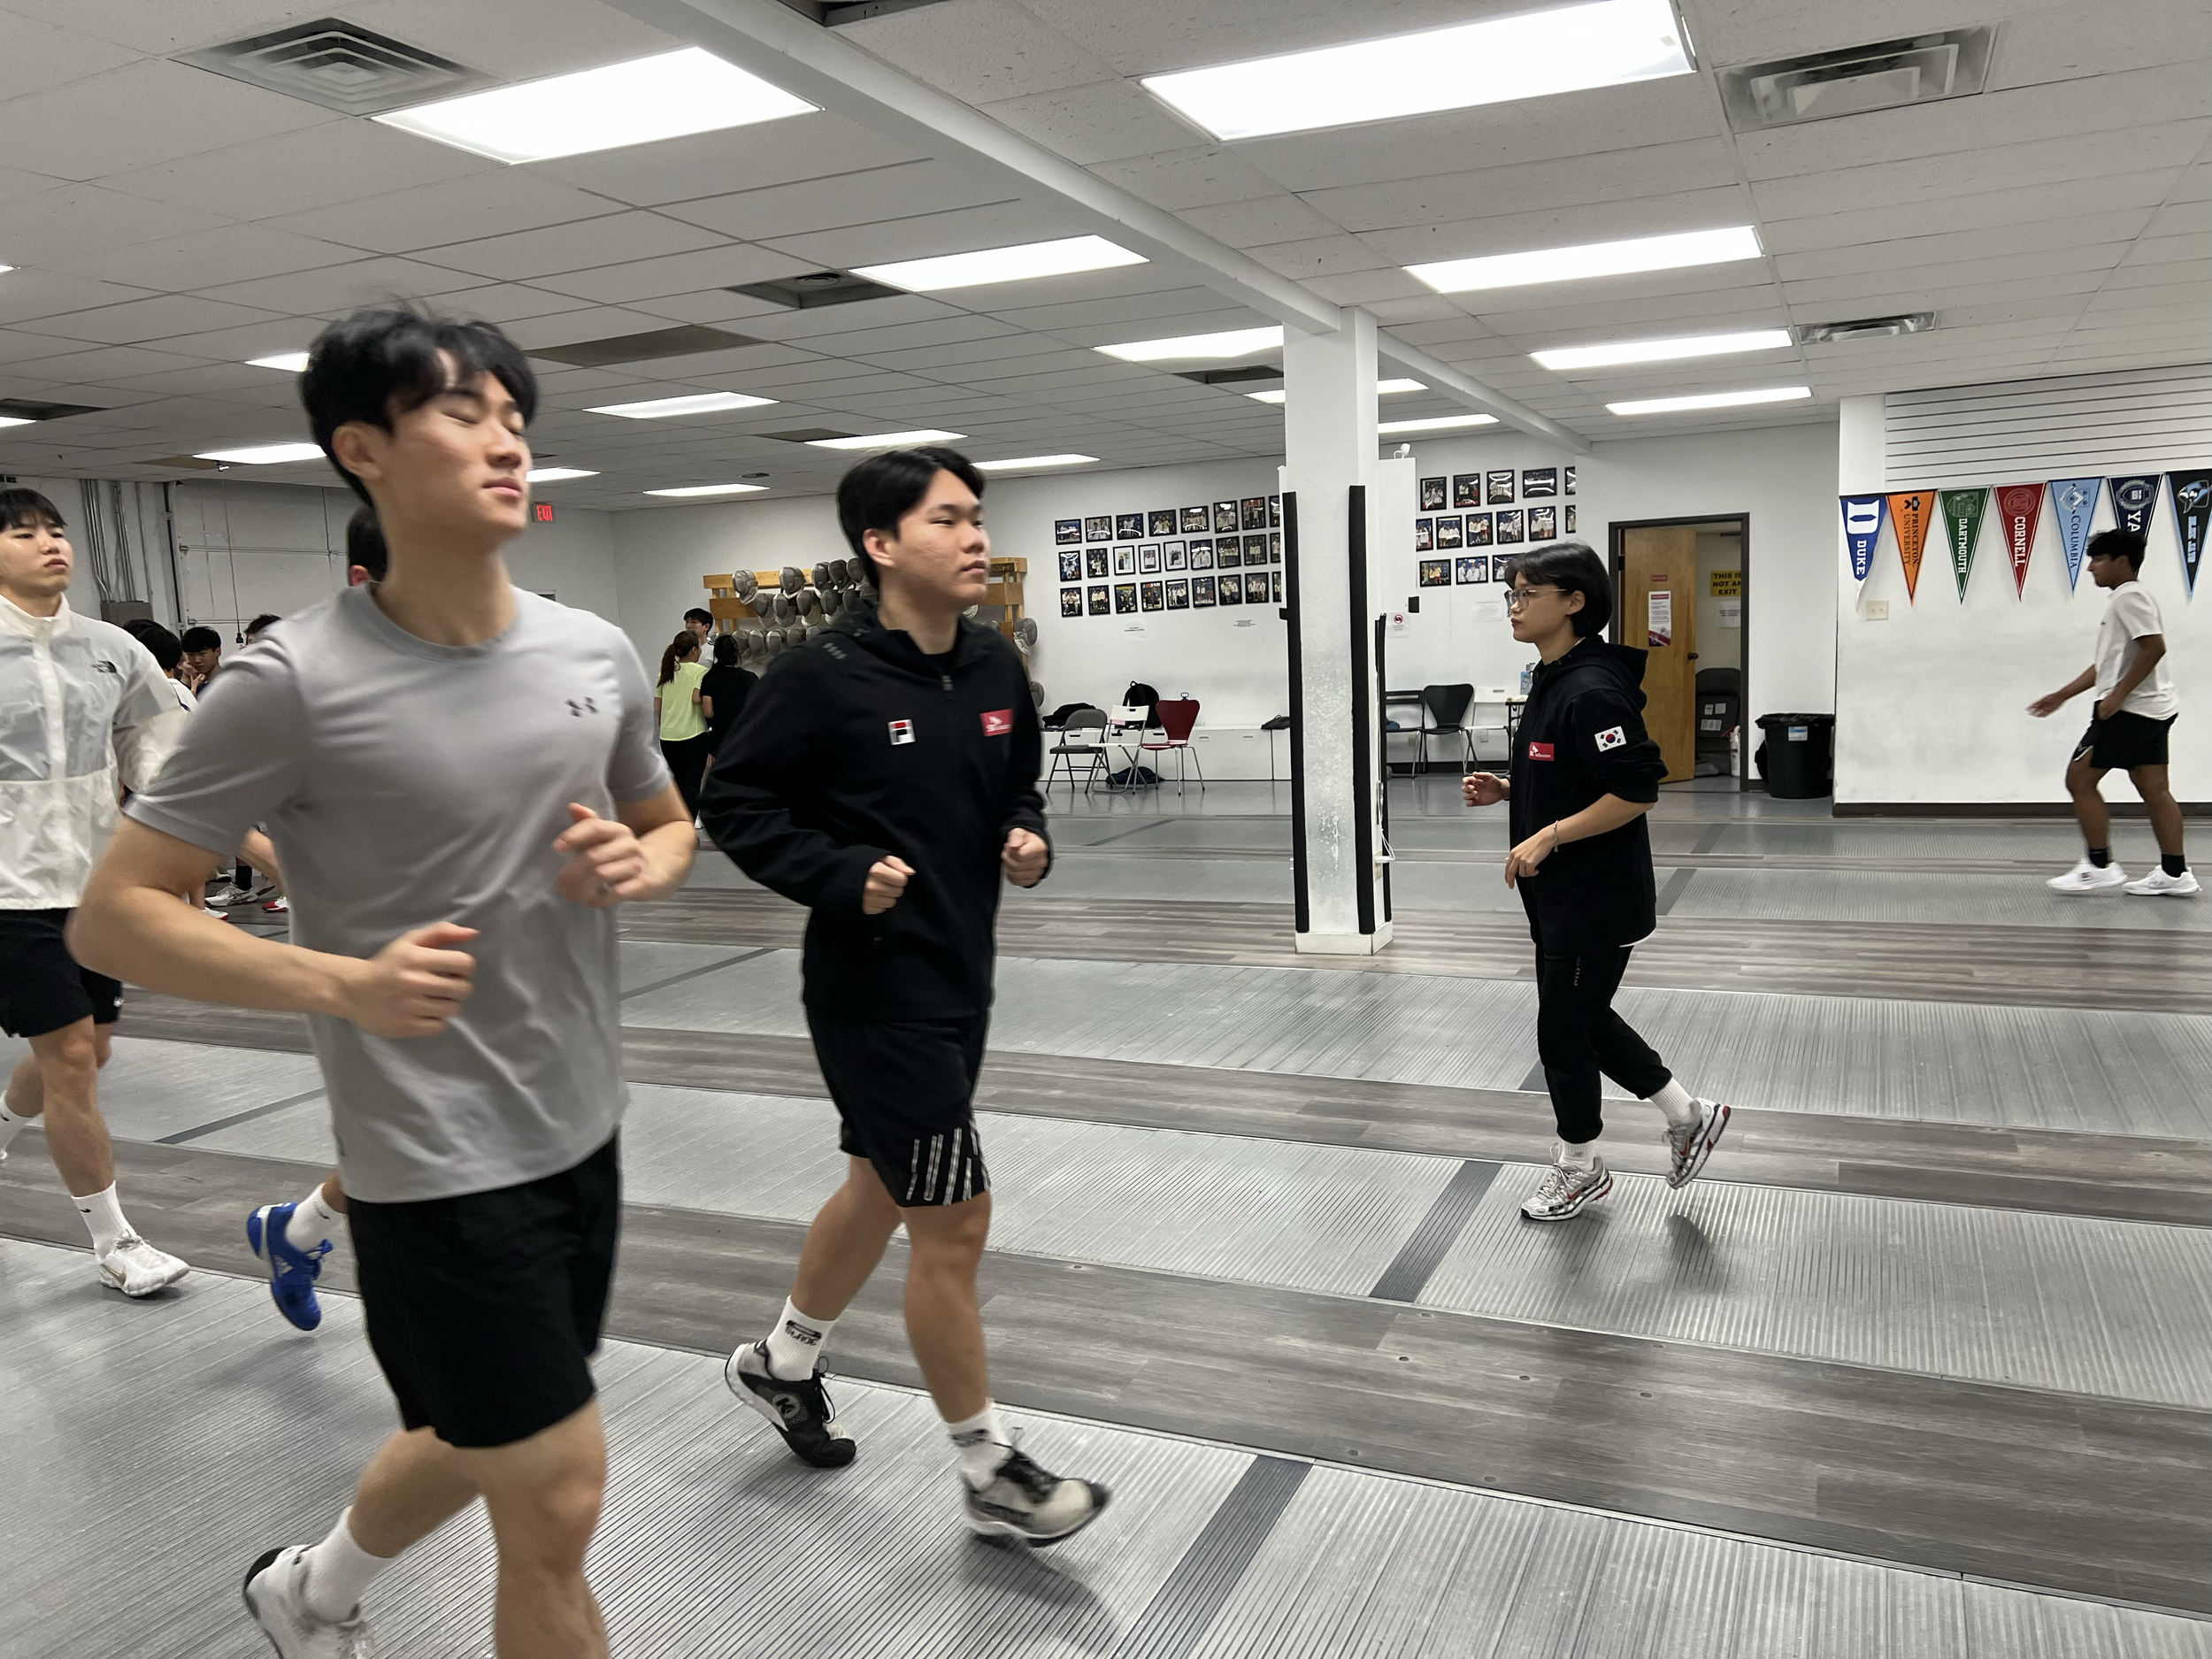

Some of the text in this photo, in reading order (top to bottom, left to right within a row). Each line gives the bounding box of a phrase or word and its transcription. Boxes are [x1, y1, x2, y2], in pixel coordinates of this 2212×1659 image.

[1958, 518, 1967, 573] DARTMOUTH
[2014, 516, 2026, 567] CORNELL
[2070, 515, 2081, 569] COLUMBIA
[2127, 511, 2142, 533] YA
[1856, 539, 1867, 575] DUKE
